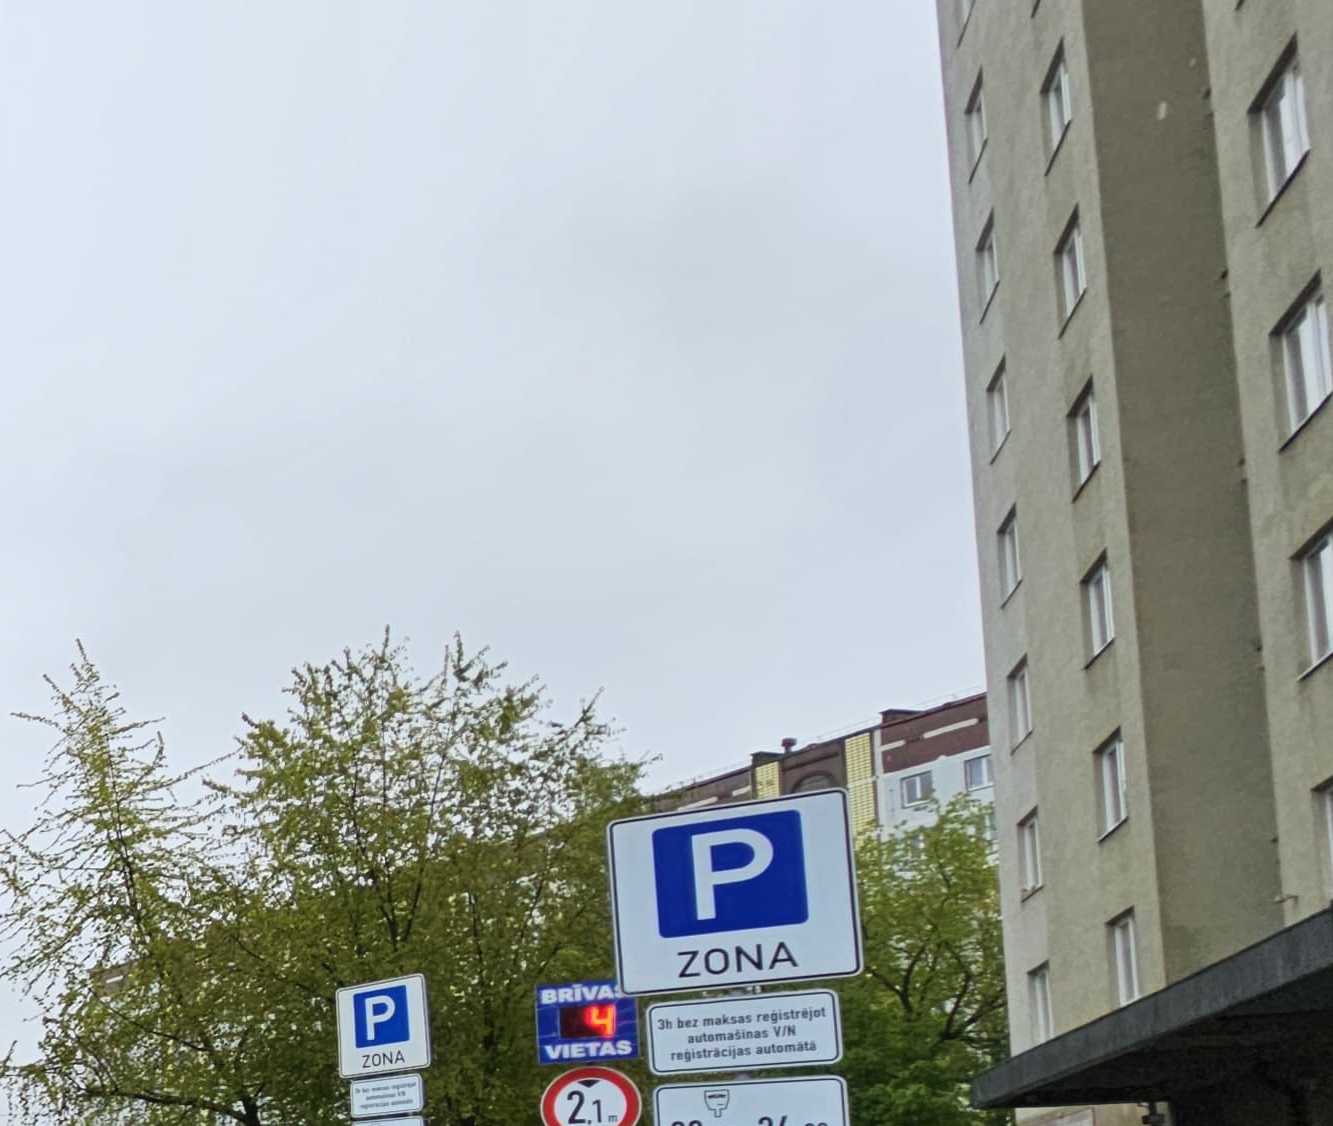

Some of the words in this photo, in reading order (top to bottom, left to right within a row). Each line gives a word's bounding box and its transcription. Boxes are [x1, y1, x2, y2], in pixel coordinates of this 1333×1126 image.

[691, 828, 774, 921] P
[677, 941, 799, 978] ZONA
[364, 995, 396, 1041] P
[586, 1004, 616, 1038] 4
[657, 1018, 672, 1030] 3h
[677, 1016, 699, 1029] bez
[702, 1012, 752, 1027] maksas
[756, 1007, 826, 1025] reģistrējot
[773, 1024, 797, 1038] V/N
[362, 1050, 405, 1068] ZONA
[544, 1040, 632, 1060] VIETAS
[755, 1040, 817, 1055] automātā
